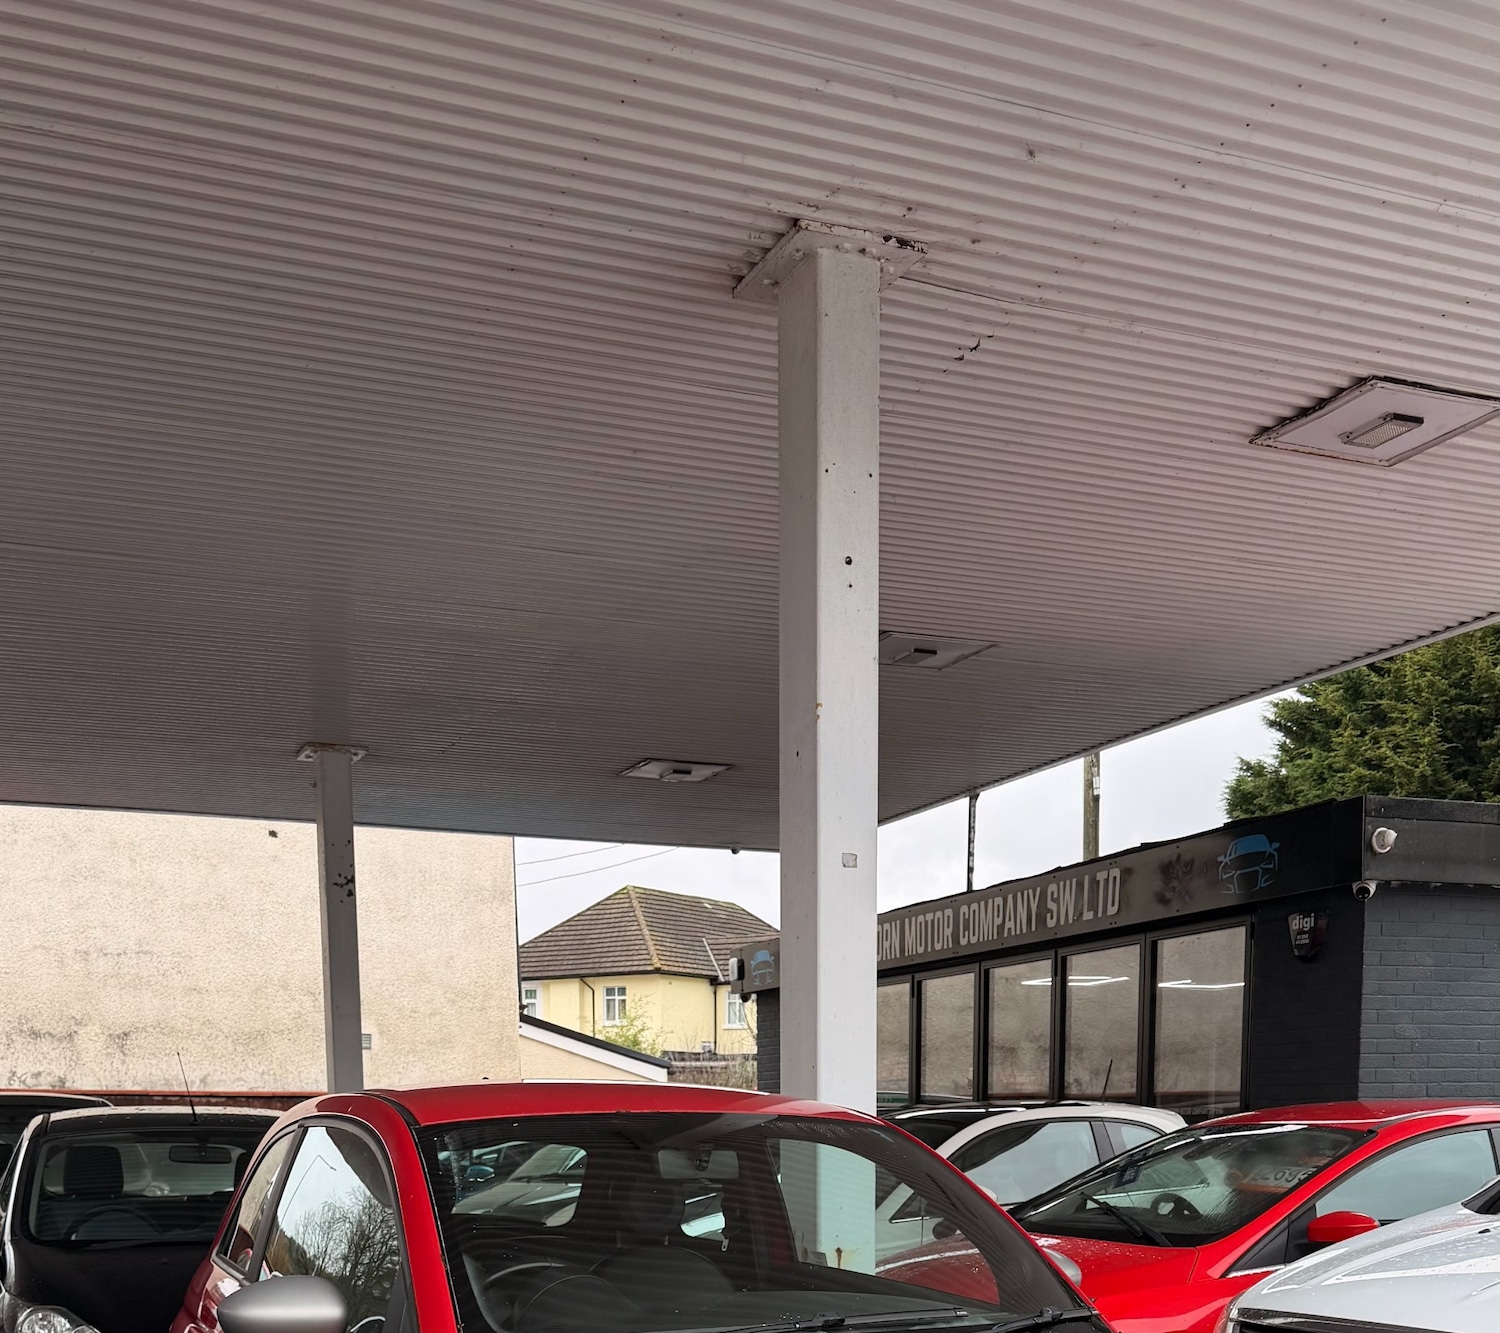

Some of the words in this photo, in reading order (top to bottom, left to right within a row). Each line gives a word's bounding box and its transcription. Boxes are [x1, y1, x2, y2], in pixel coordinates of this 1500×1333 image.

[905, 908, 954, 956] MOTOR
[959, 887, 1041, 946] COMPANY
[1082, 868, 1121, 921] LTD
[1292, 912, 1315, 931] digi
